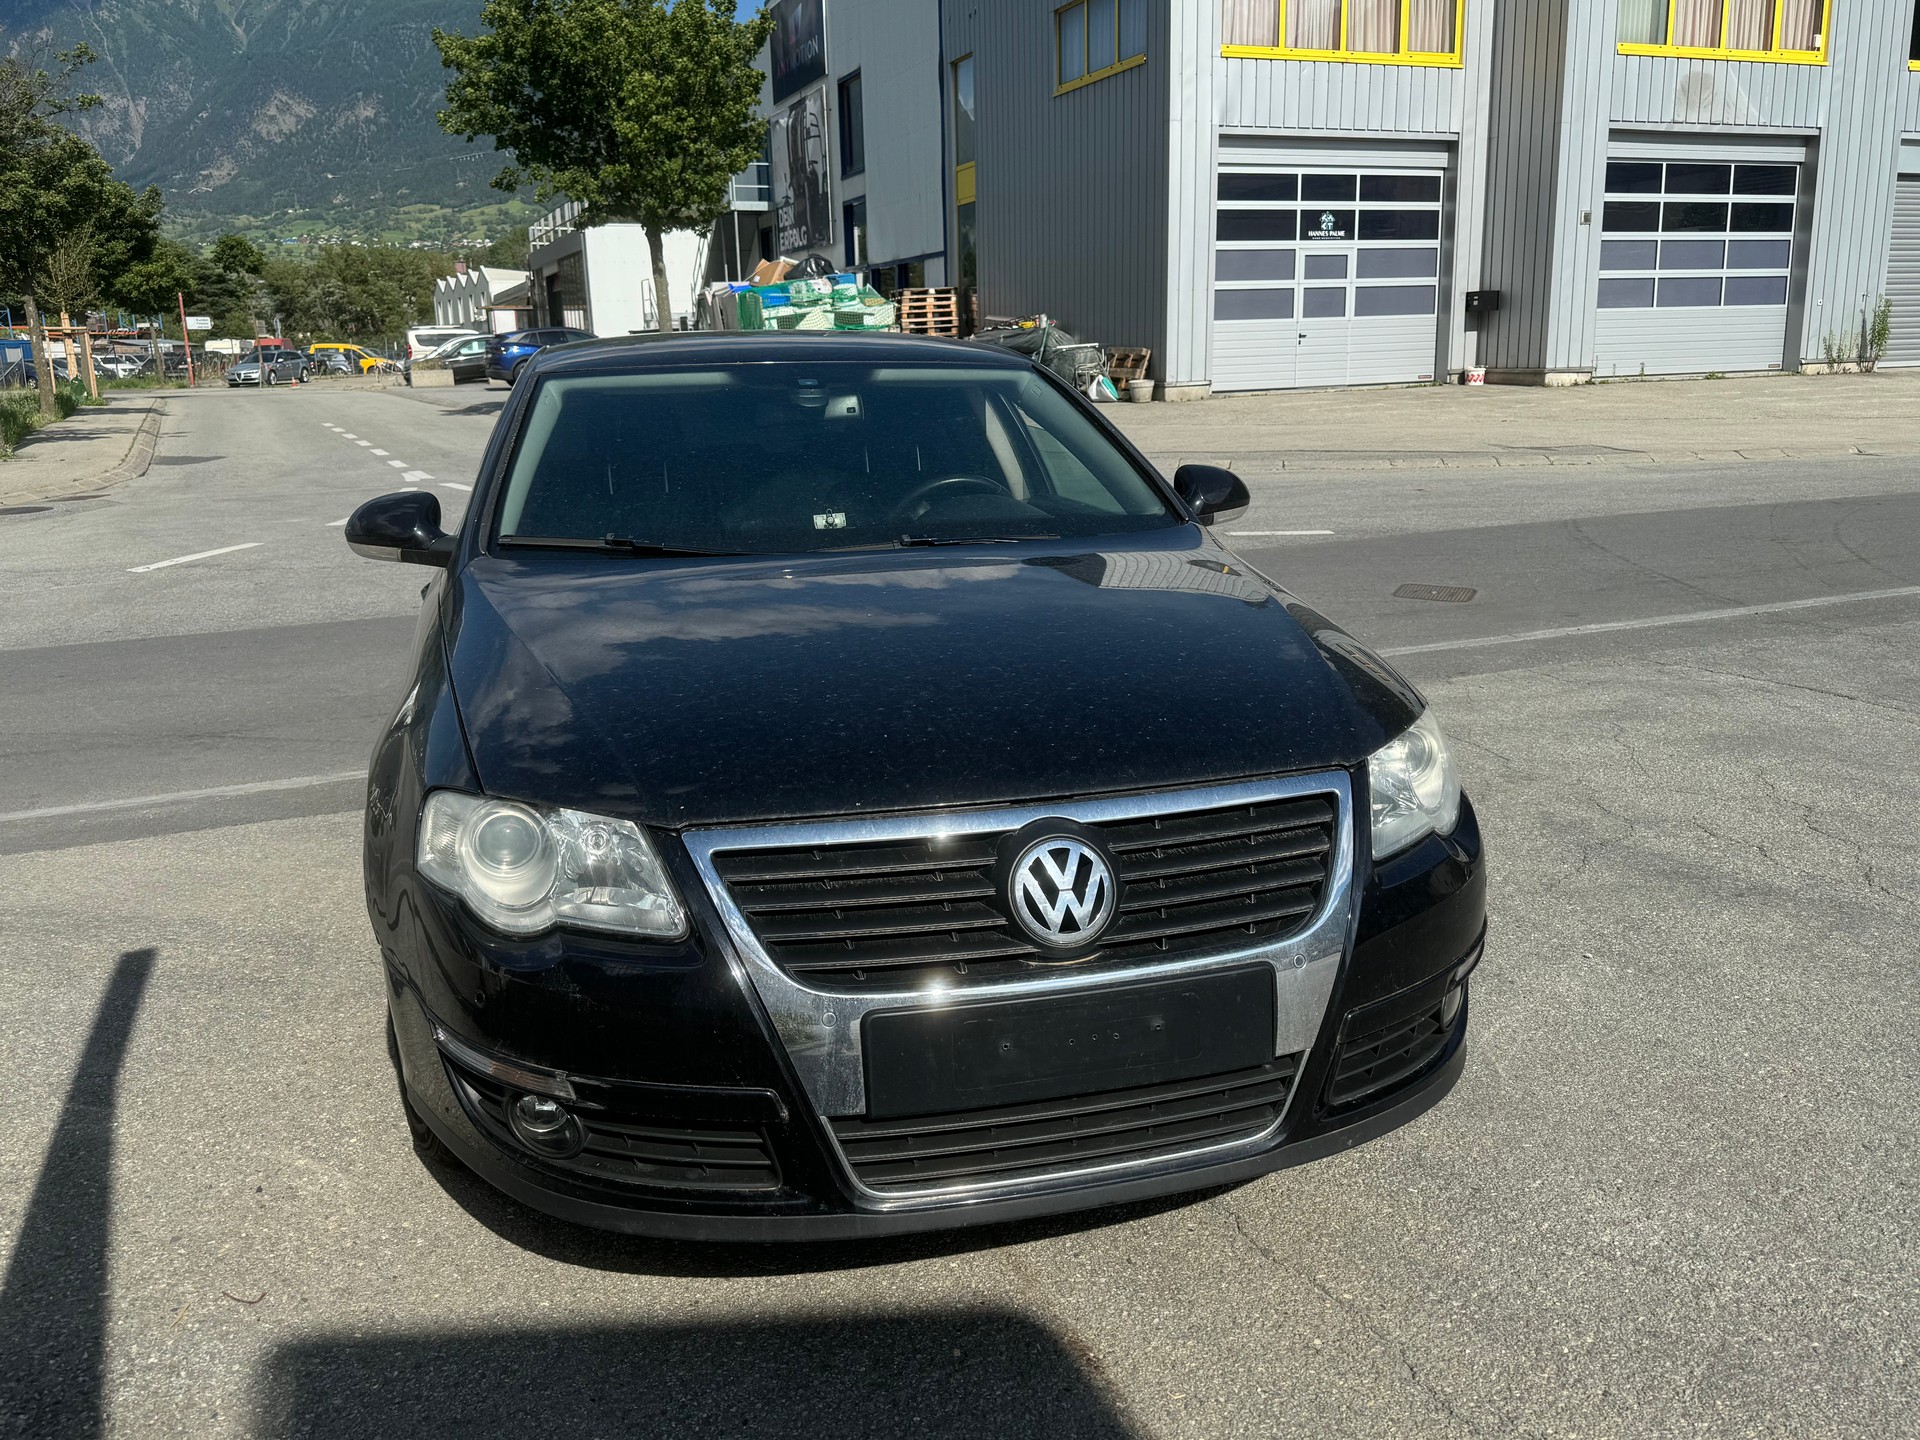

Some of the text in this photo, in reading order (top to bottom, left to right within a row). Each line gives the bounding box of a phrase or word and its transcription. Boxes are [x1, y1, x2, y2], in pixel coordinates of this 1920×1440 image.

[778, 204, 795, 228] DEIN
[779, 225, 808, 251] ERFOLG
[1016, 840, 1112, 942] VW
